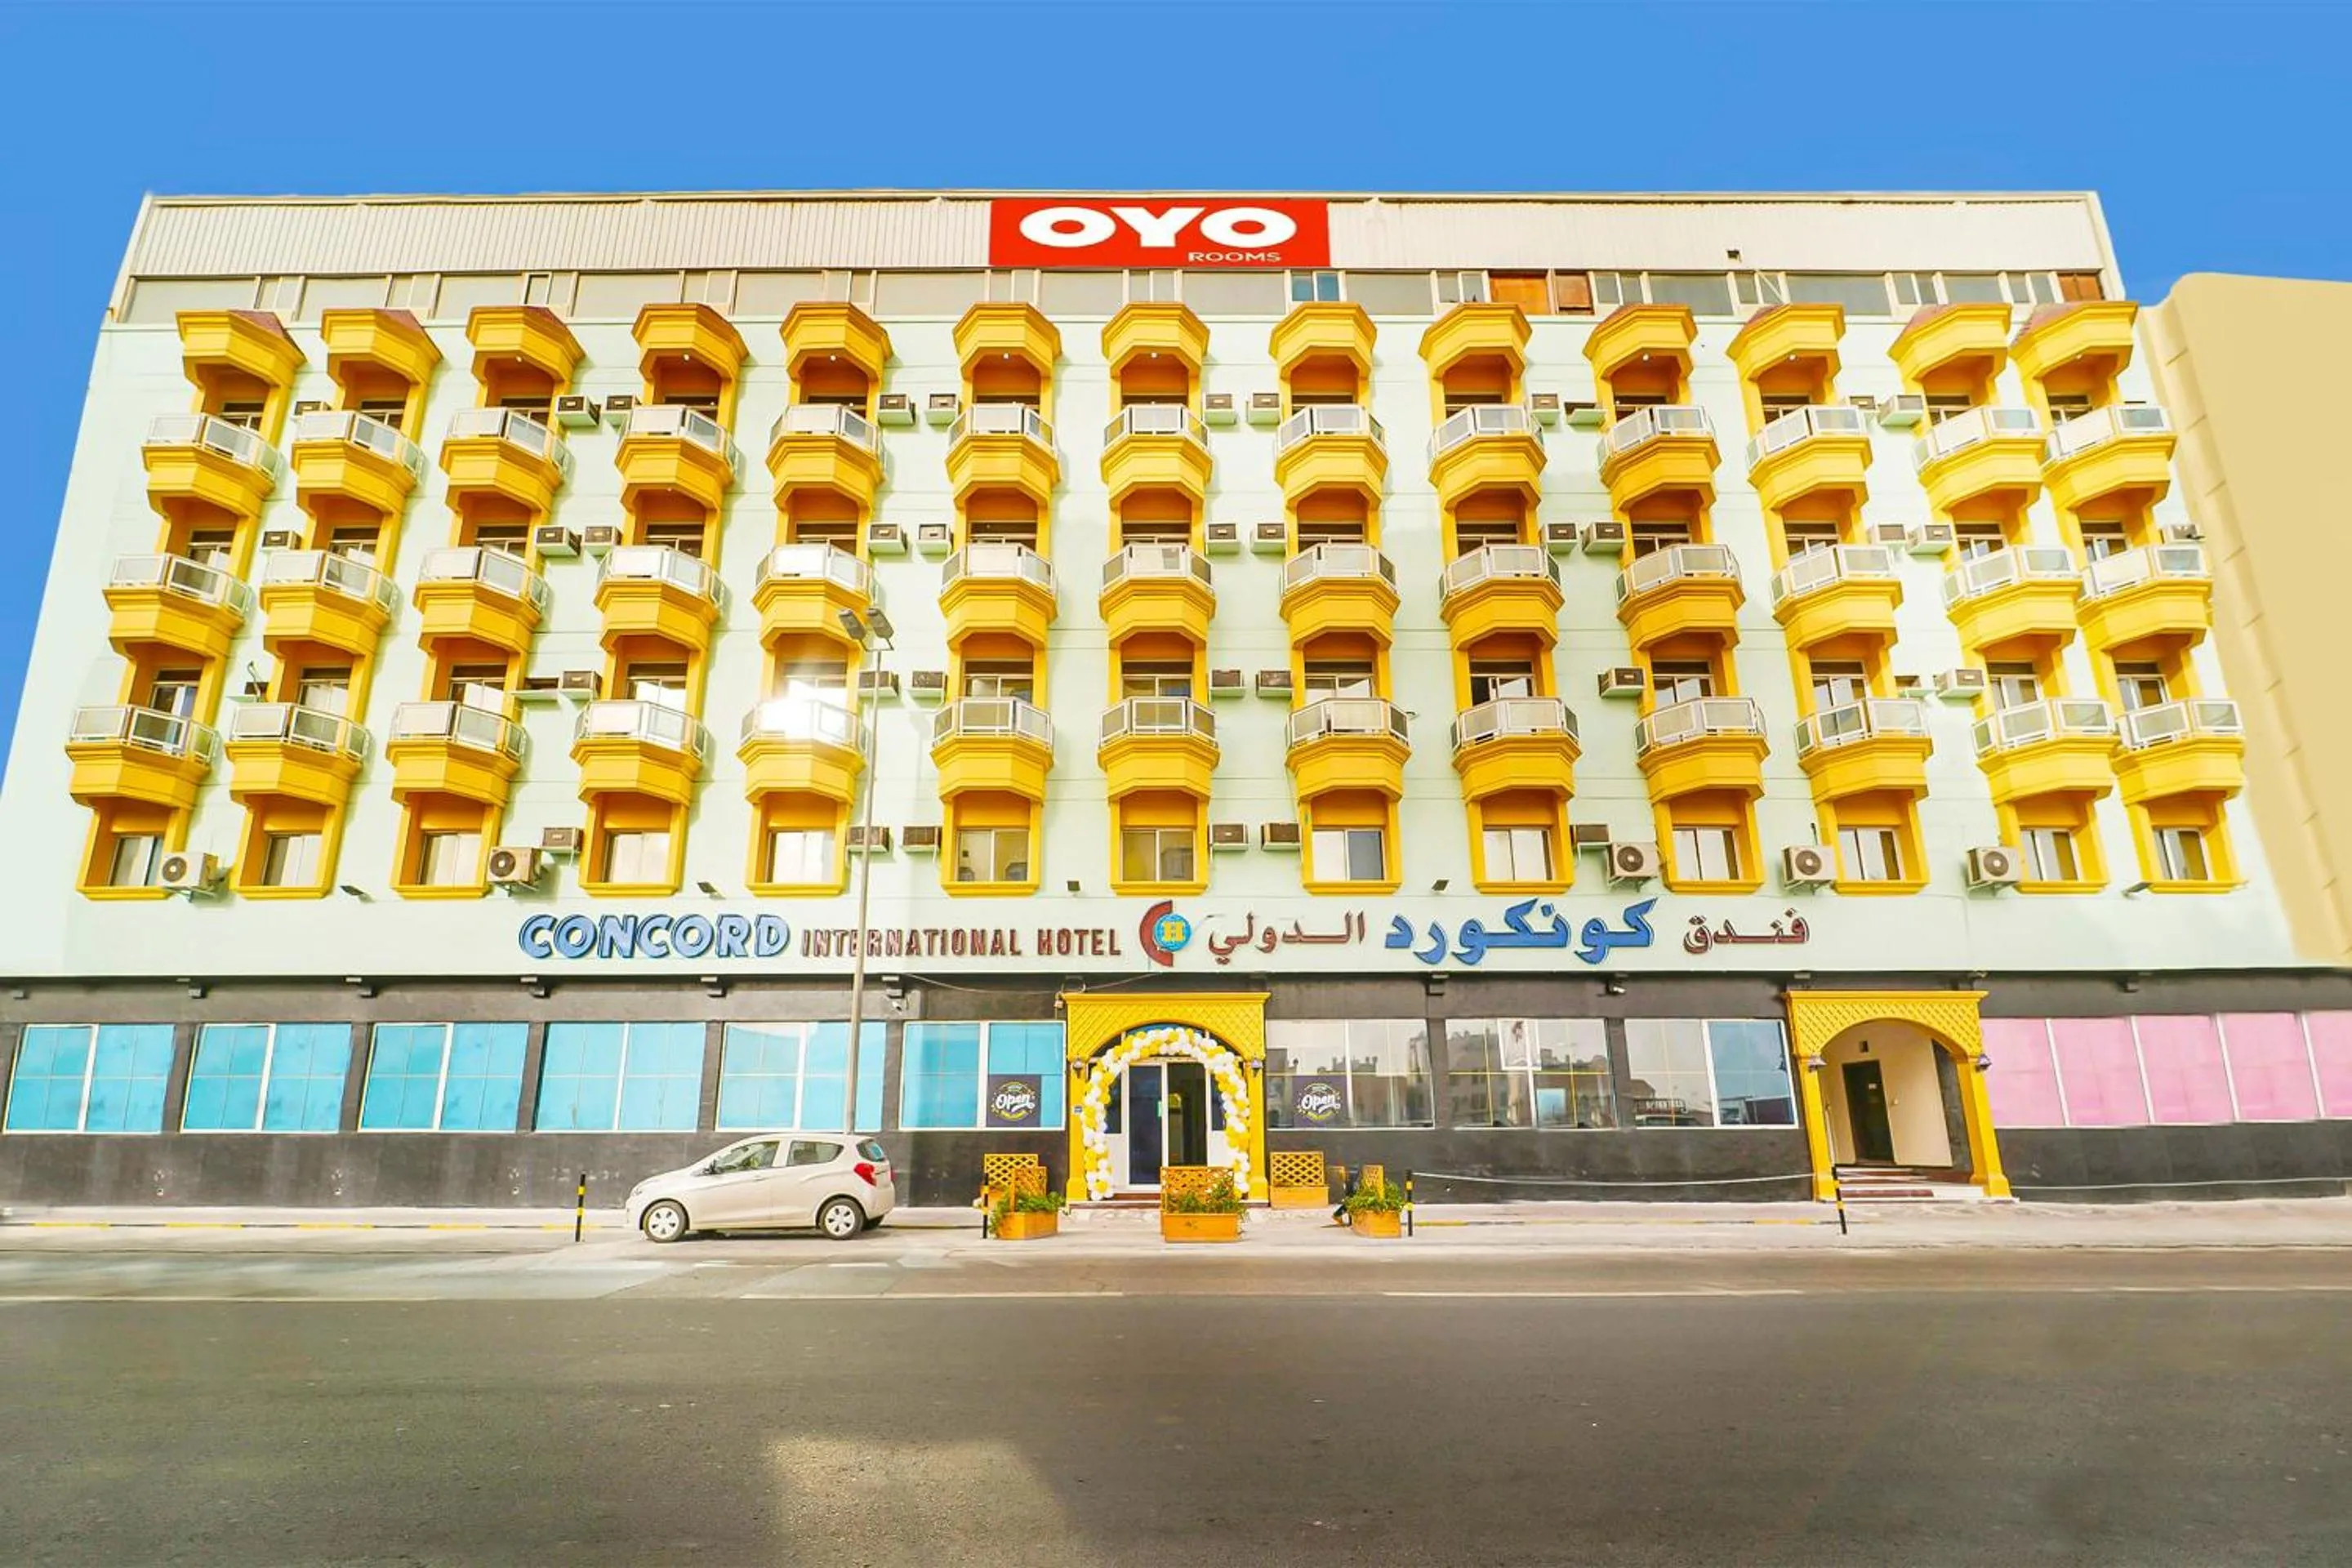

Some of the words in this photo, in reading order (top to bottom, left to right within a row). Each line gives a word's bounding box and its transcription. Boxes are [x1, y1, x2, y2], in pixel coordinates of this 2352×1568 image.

[1018, 206, 1297, 247] OYO
[1188, 252, 1281, 262] ROOMS
[519, 914, 791, 959] CONCORD
[801, 929, 1022, 957] INTERNATIONAL
[1037, 929, 1122, 956] HOTEL
[1208, 911, 1365, 965] الدولي
[1384, 897, 1659, 965] كونكورد
[1682, 906, 1811, 955] فندق
[996, 1094, 1036, 1112] Open
[1301, 1094, 1341, 1114] Open
